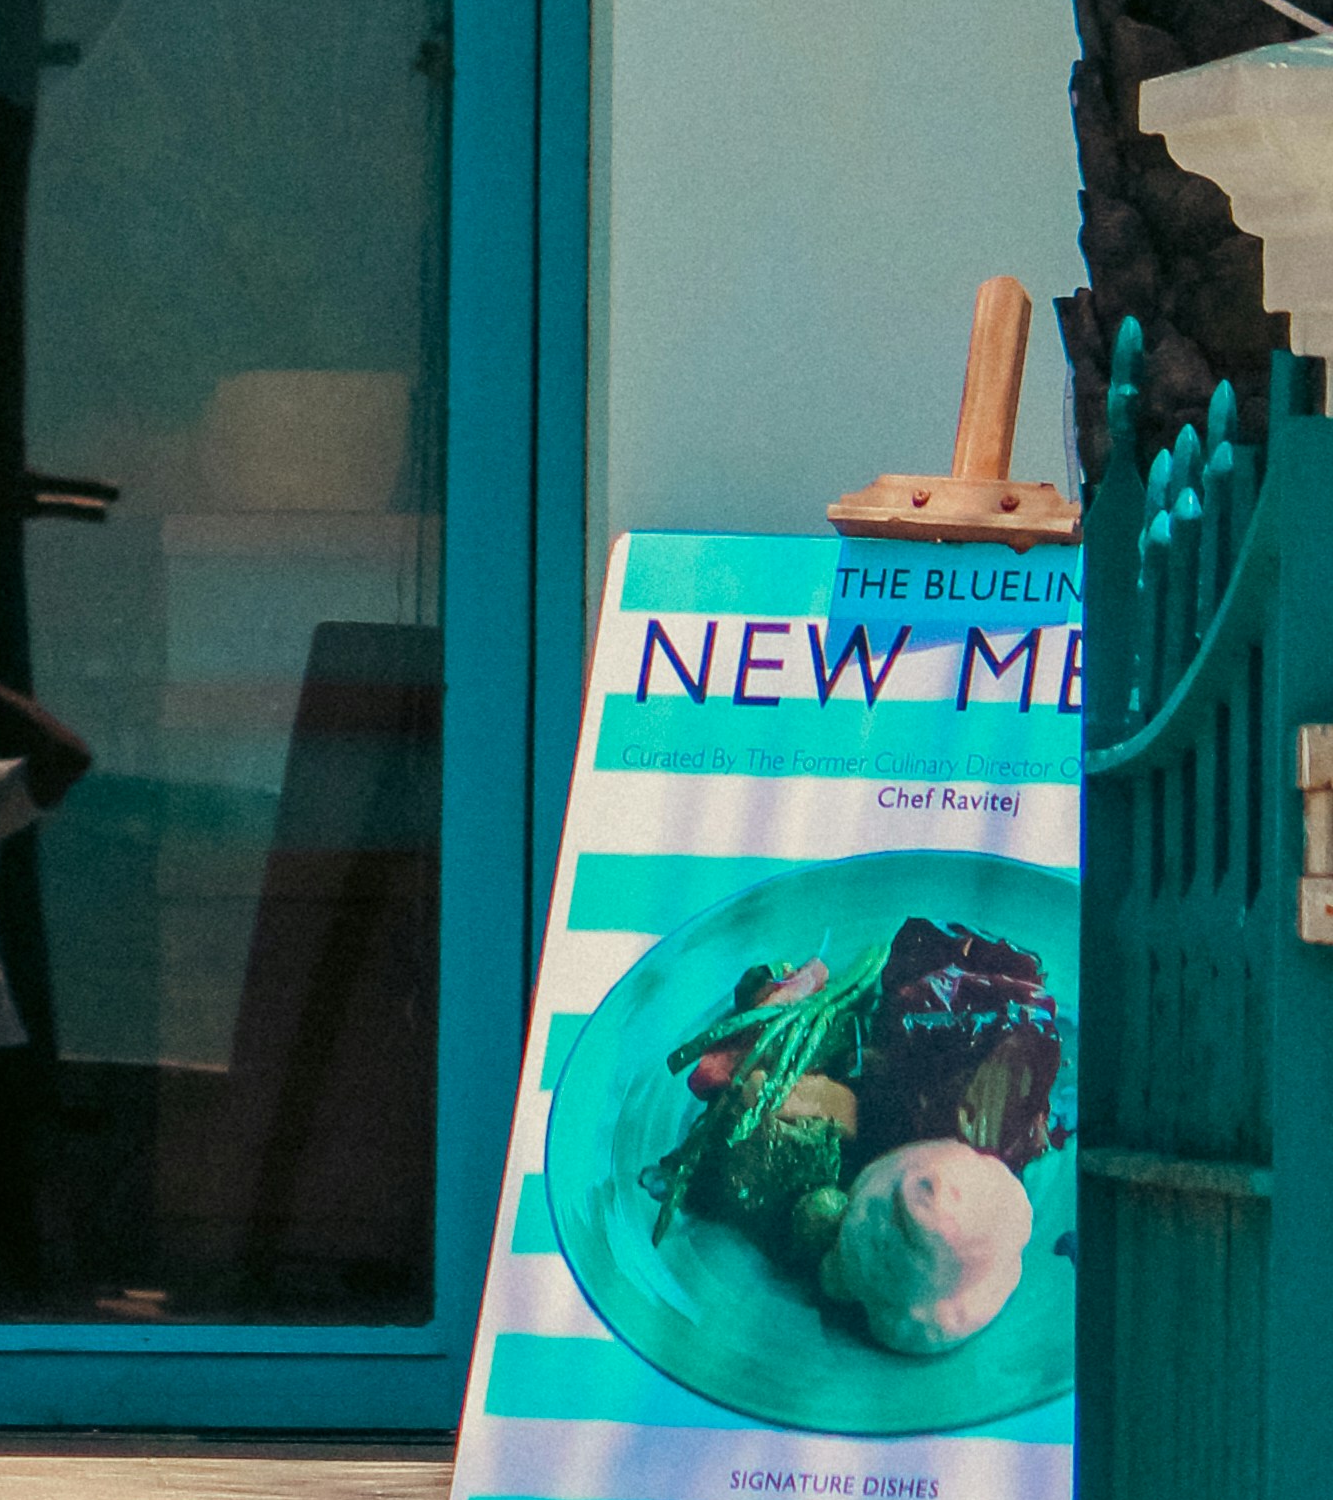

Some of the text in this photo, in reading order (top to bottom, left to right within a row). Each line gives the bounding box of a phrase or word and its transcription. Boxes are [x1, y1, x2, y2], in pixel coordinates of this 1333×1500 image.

[837, 568, 910, 599] THE
[636, 619, 912, 709] NEW
[622, 744, 705, 769] Curated
[712, 748, 737, 774] By
[747, 748, 784, 770] The
[792, 750, 867, 773] Former
[875, 751, 959, 778] Culinary
[966, 753, 1053, 778] Director
[878, 787, 1021, 817] Chef Ravitej
[730, 1470, 939, 1499] SIGNATURE DISHES
